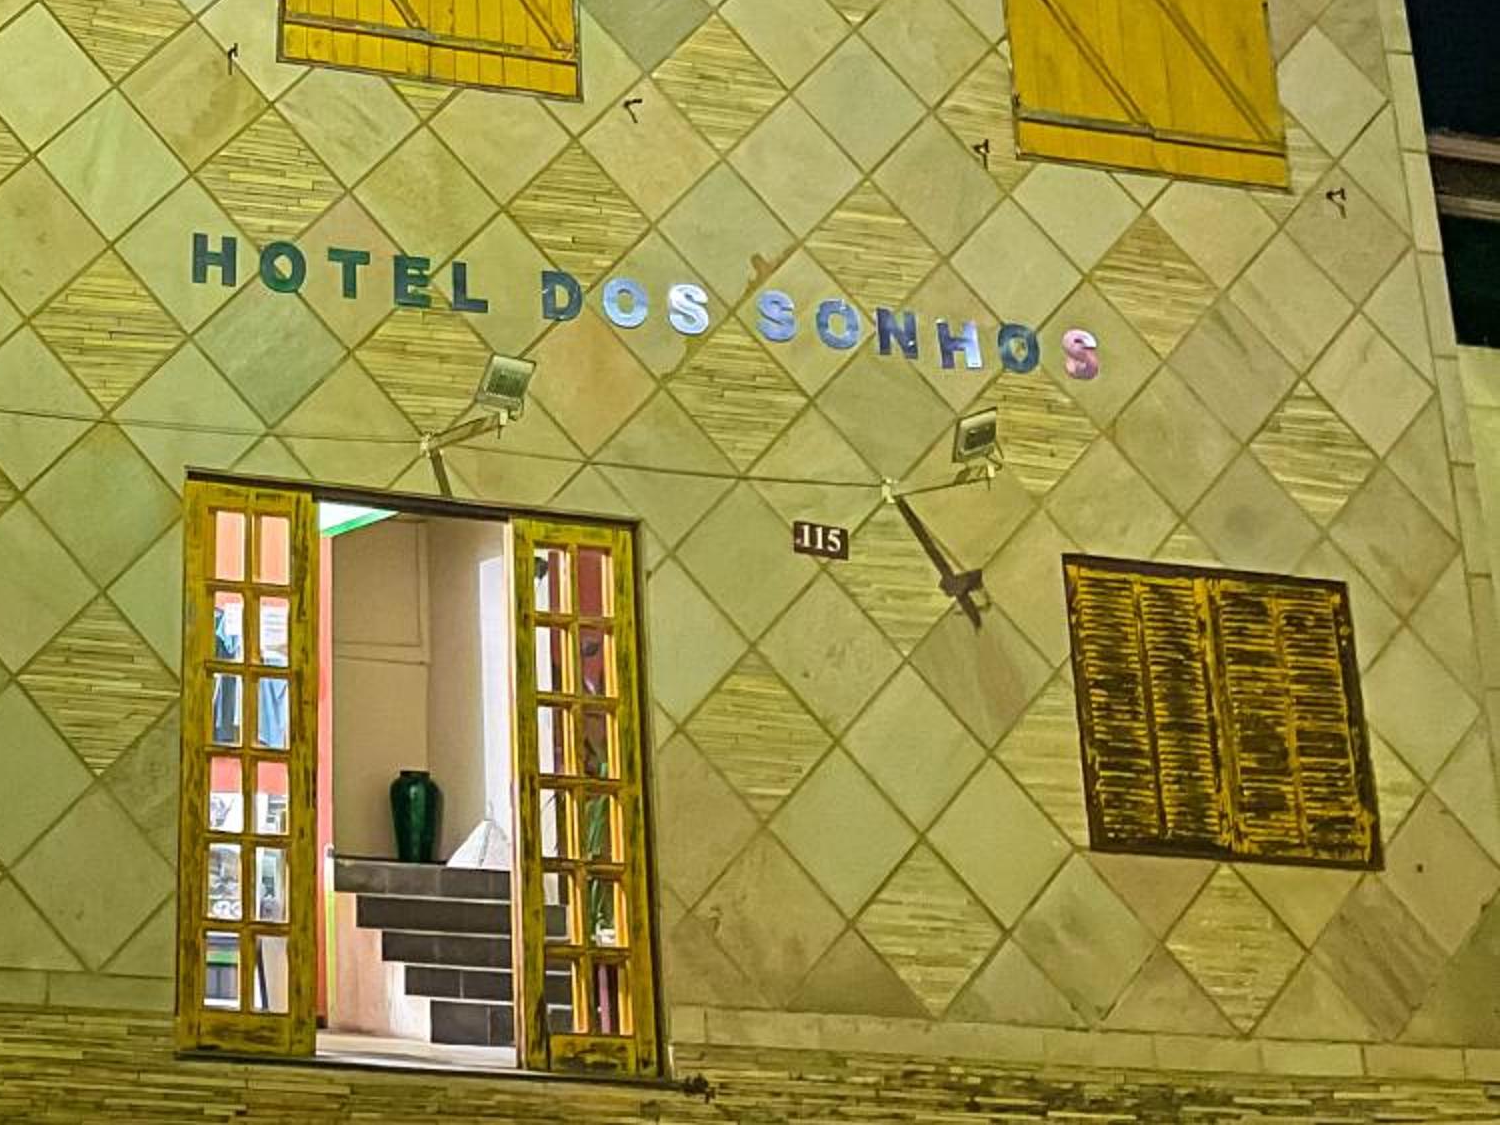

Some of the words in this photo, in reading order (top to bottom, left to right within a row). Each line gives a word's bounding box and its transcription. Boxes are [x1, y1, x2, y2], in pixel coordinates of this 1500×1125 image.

[190, 232, 489, 314] HOTEL
[540, 269, 711, 335] DOS
[756, 288, 1102, 381] SONHOS
[800, 524, 842, 552] 115
